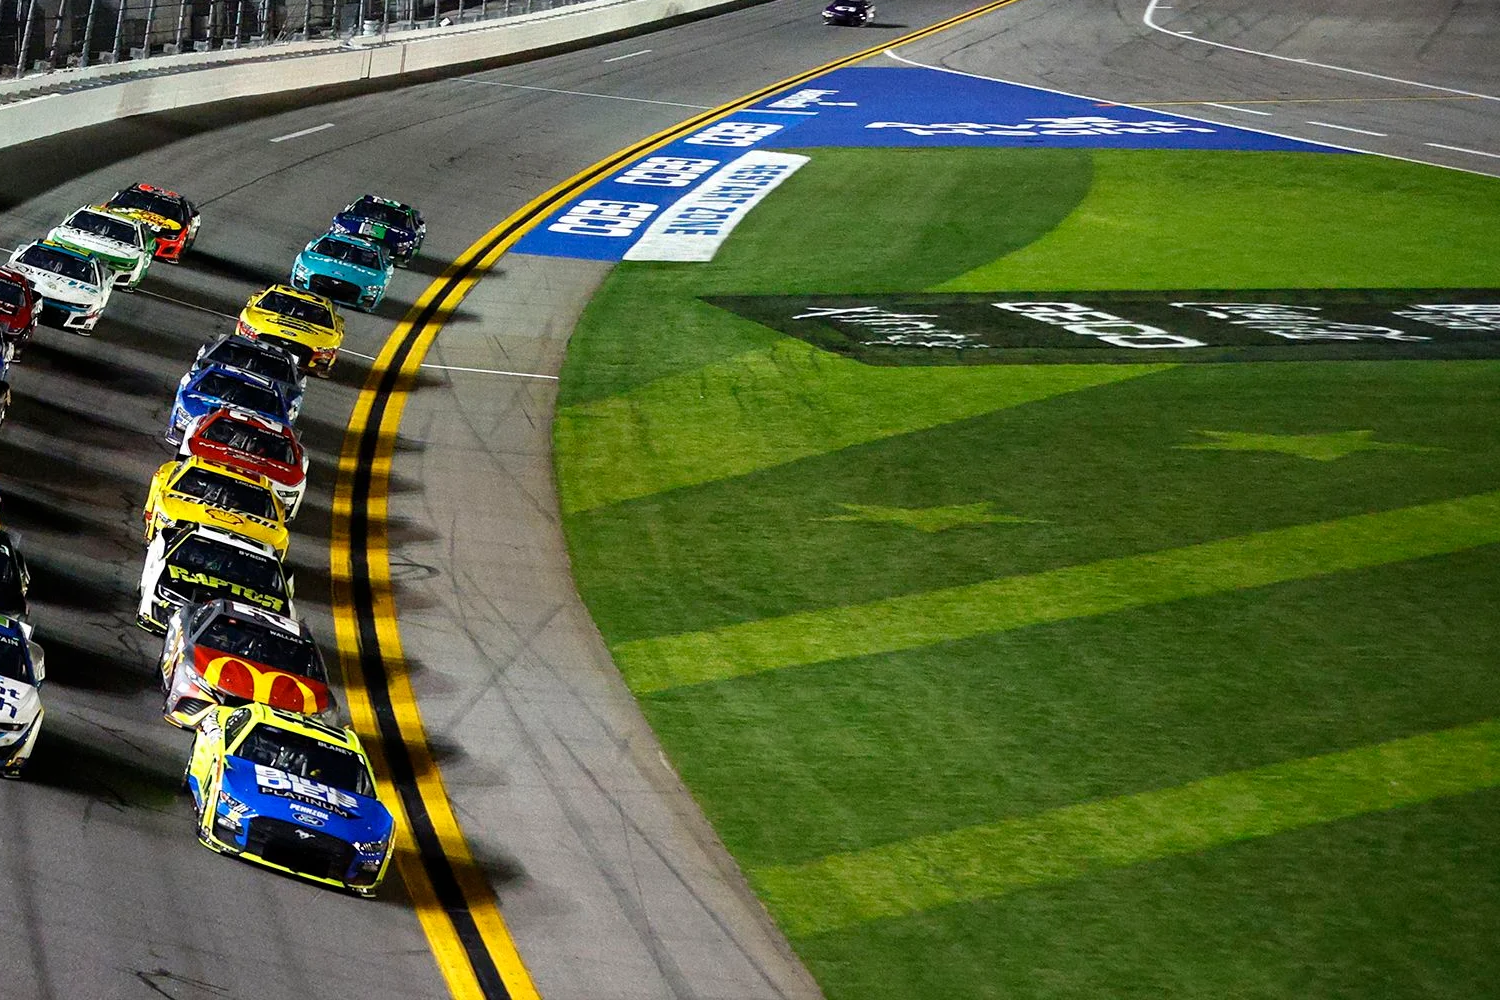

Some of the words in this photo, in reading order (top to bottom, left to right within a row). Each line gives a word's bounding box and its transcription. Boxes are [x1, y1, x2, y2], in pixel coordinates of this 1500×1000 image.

[684, 121, 784, 147] GEICO
[864, 120, 1188, 129] Advent
[903, 127, 1217, 137] Health
[614, 156, 720, 187] GEICO
[697, 164, 789, 205] RESTART
[548, 199, 659, 237] GEICO
[663, 206, 738, 236] ZONE
[992, 301, 1208, 349] GEICO
[238, 550, 267, 562] BYRON
[167, 564, 284, 612] RAPTOR
[269, 630, 303, 645] WALLACE
[317, 740, 352, 756] BLANEY
[262, 787, 348, 817] PLATINUM
[289, 803, 329, 820] PENNZOIL
